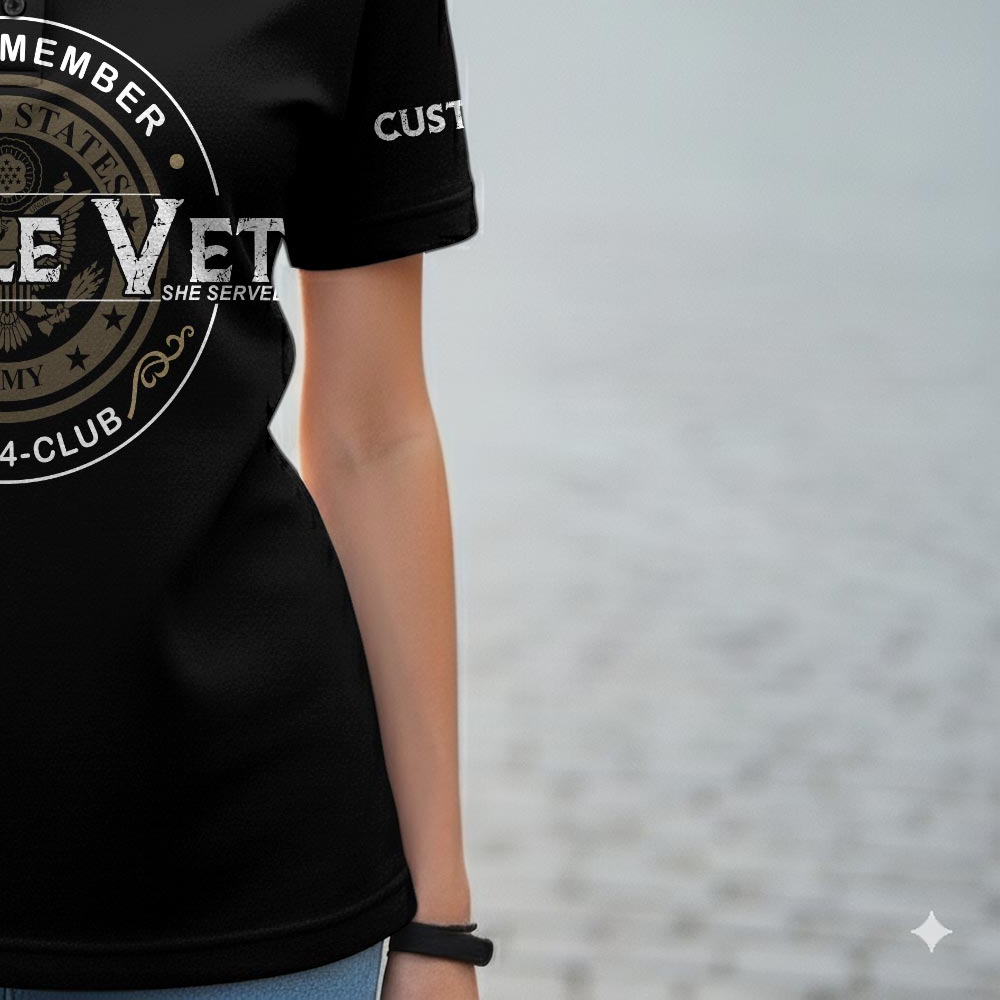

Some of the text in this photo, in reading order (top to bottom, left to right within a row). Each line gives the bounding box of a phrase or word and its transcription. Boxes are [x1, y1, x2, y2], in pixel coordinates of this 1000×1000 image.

[0, 33, 166, 137] MEMBER
[374, 99, 464, 141] CUST
[15, 102, 132, 195] STATES
[91, 198, 285, 295] VET
[161, 284, 202, 301] SHE
